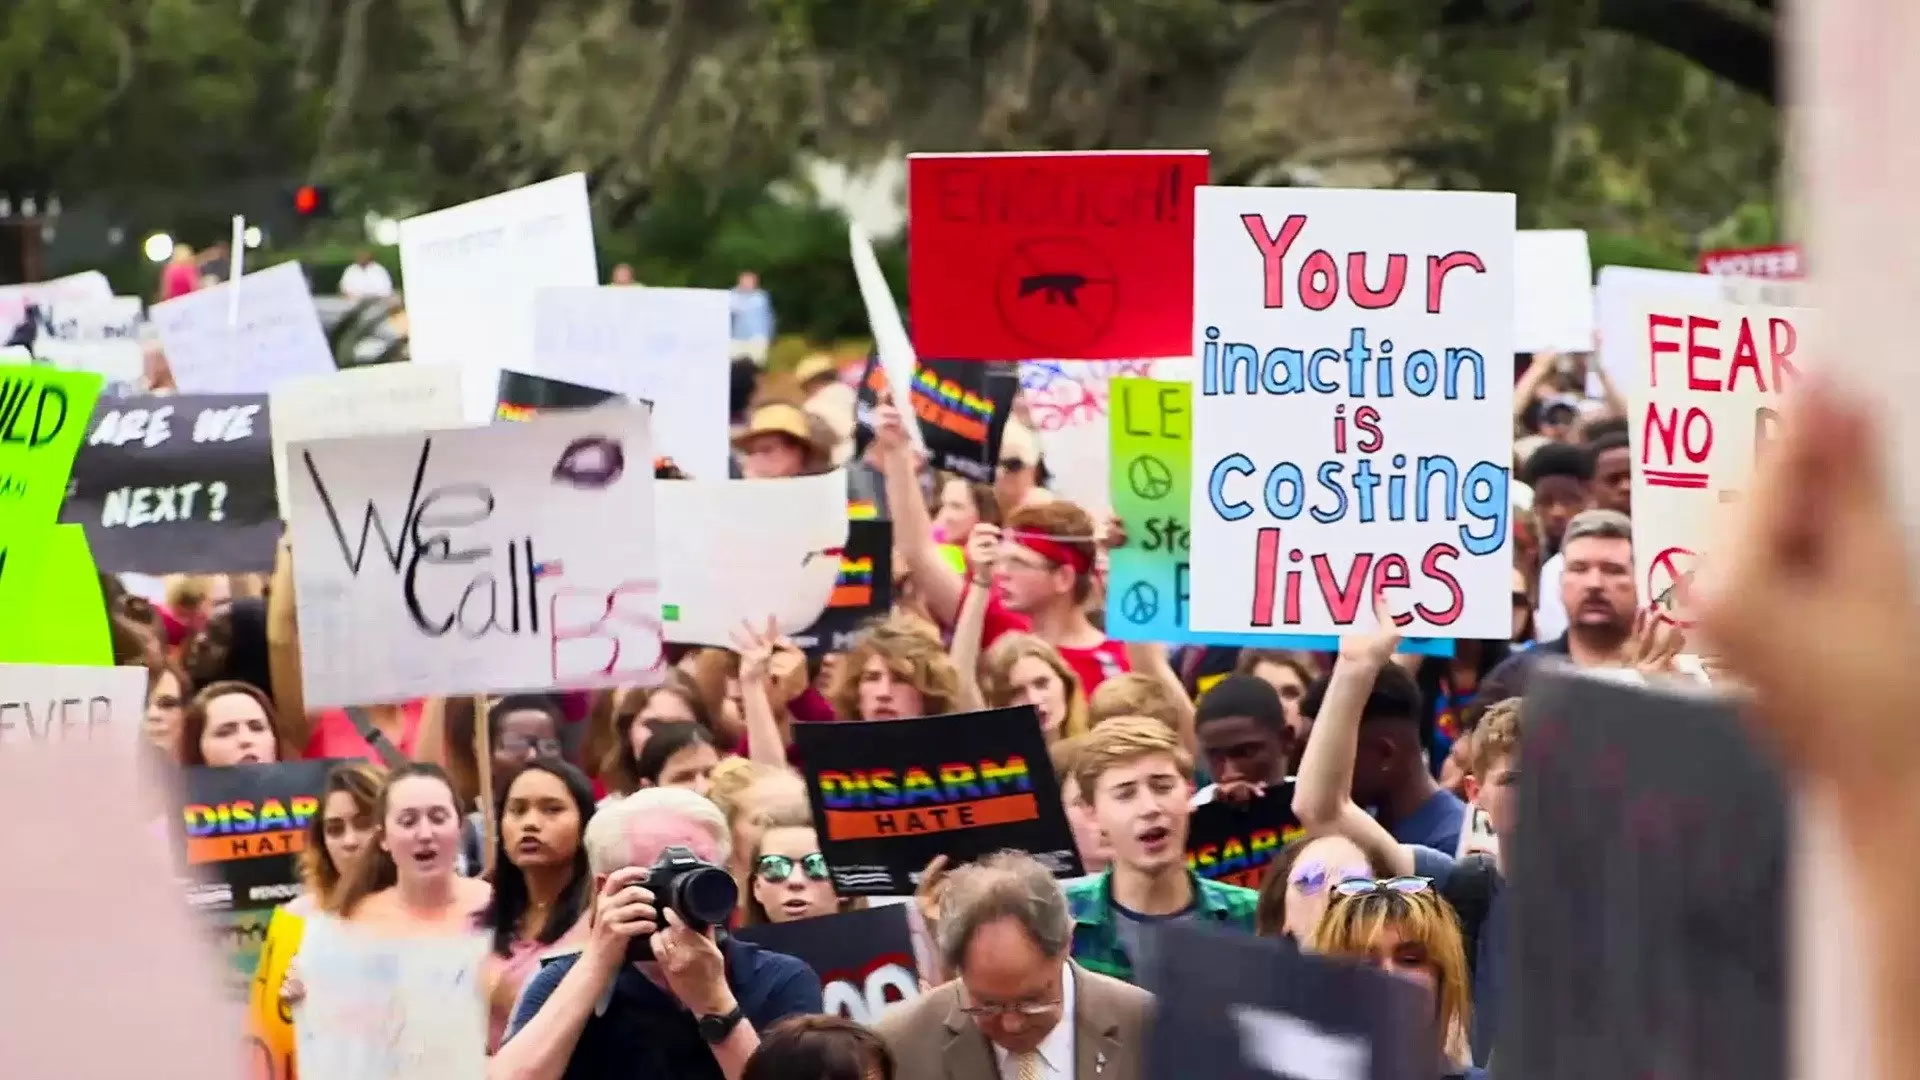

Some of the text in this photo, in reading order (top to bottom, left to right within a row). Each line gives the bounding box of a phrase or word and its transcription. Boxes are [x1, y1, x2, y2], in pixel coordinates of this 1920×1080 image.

[1240, 213, 1486, 314] Your
[1203, 325, 1485, 400] inaction
[1648, 313, 1803, 393] FEAR
[89, 405, 174, 448] ARE
[192, 404, 261, 443] WE
[1122, 385, 1183, 440] LE
[1334, 404, 1384, 453] is
[1641, 402, 1713, 465] NO
[303, 436, 495, 577] We
[1250, 527, 1465, 627] lives
[550, 578, 666, 684] BS
[818, 754, 1035, 808] DISARM
[183, 795, 319, 836] DISAR
[875, 805, 976, 836] HATE
